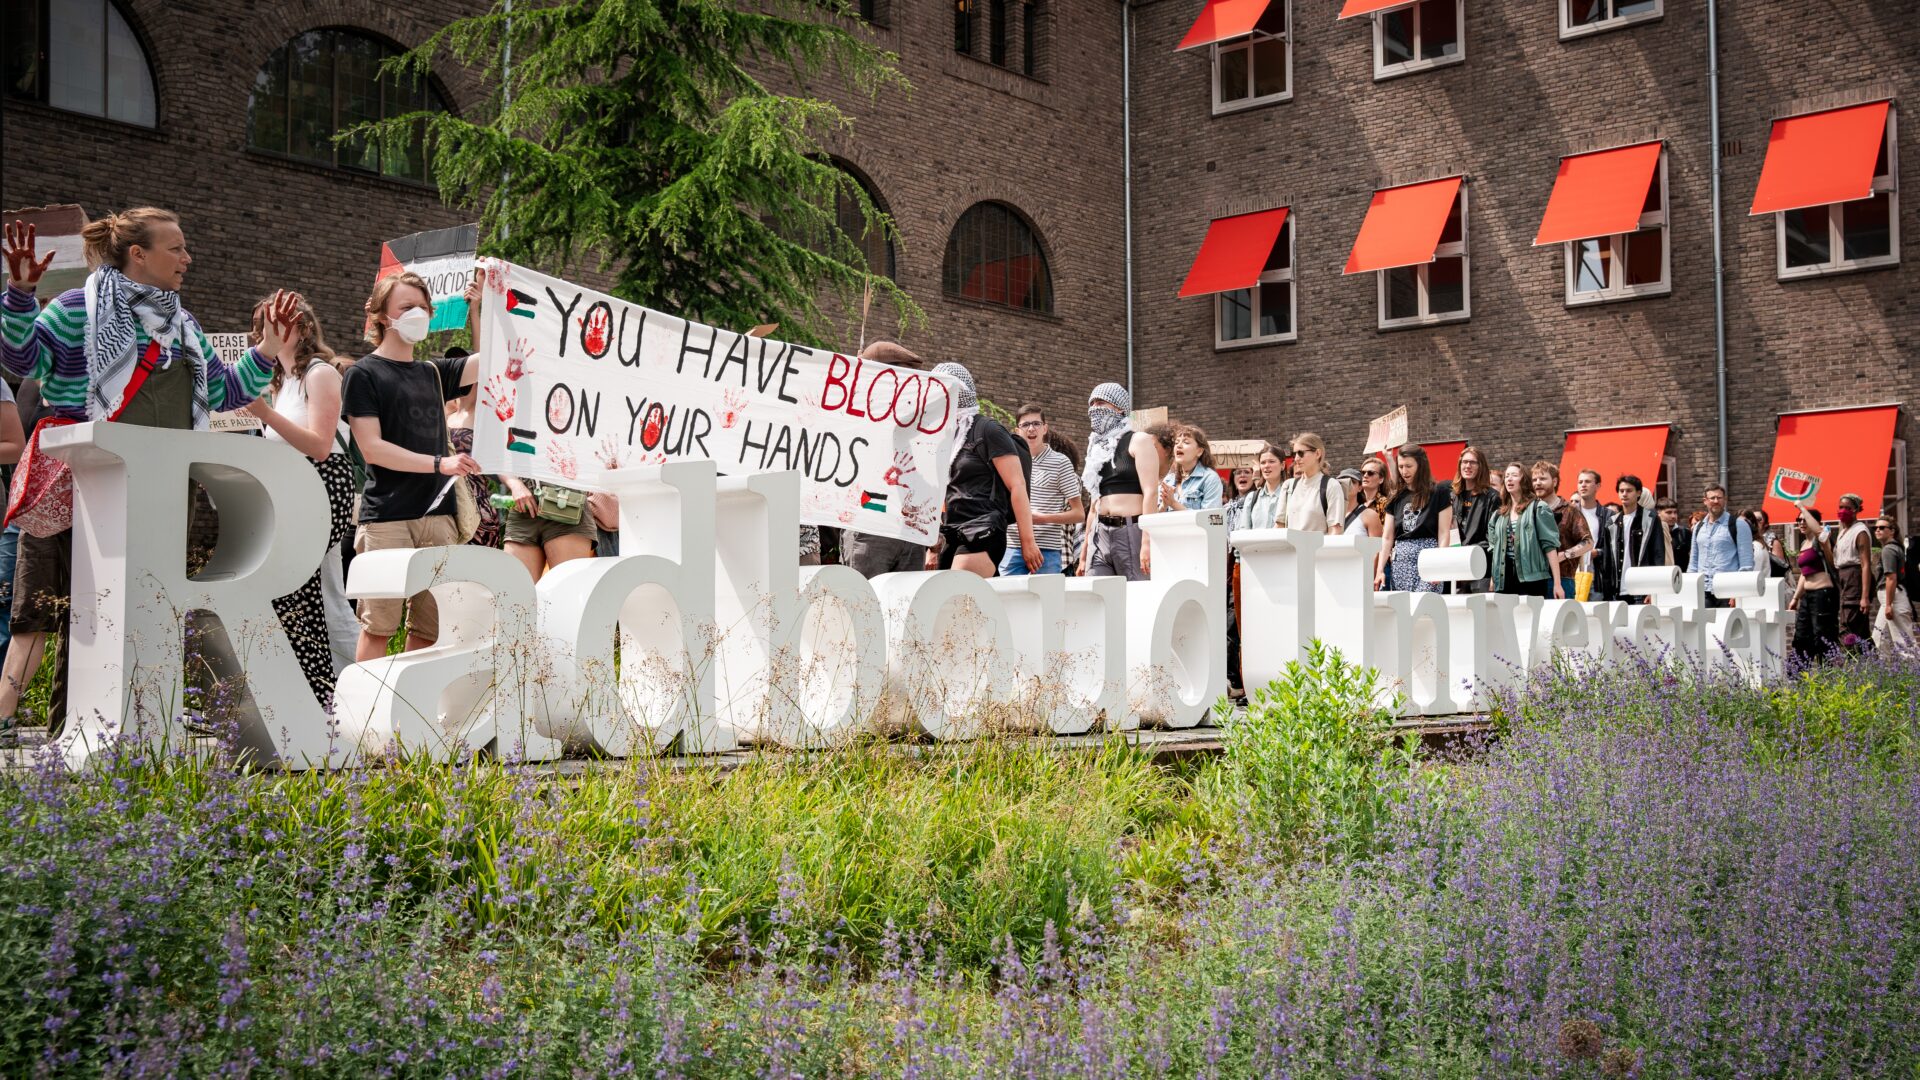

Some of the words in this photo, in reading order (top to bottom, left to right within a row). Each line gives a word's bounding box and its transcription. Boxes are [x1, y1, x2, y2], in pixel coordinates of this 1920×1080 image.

[212, 335, 245, 348] CEASE
[545, 286, 647, 369] YOU
[676, 320, 814, 404] HAVE
[821, 353, 951, 436] BLOOD
[209, 419, 228, 429] FREE
[544, 382, 601, 439] ON
[625, 396, 712, 459] YOUR
[739, 420, 869, 488] HANDS
[40, 421, 1227, 772] Radboud
